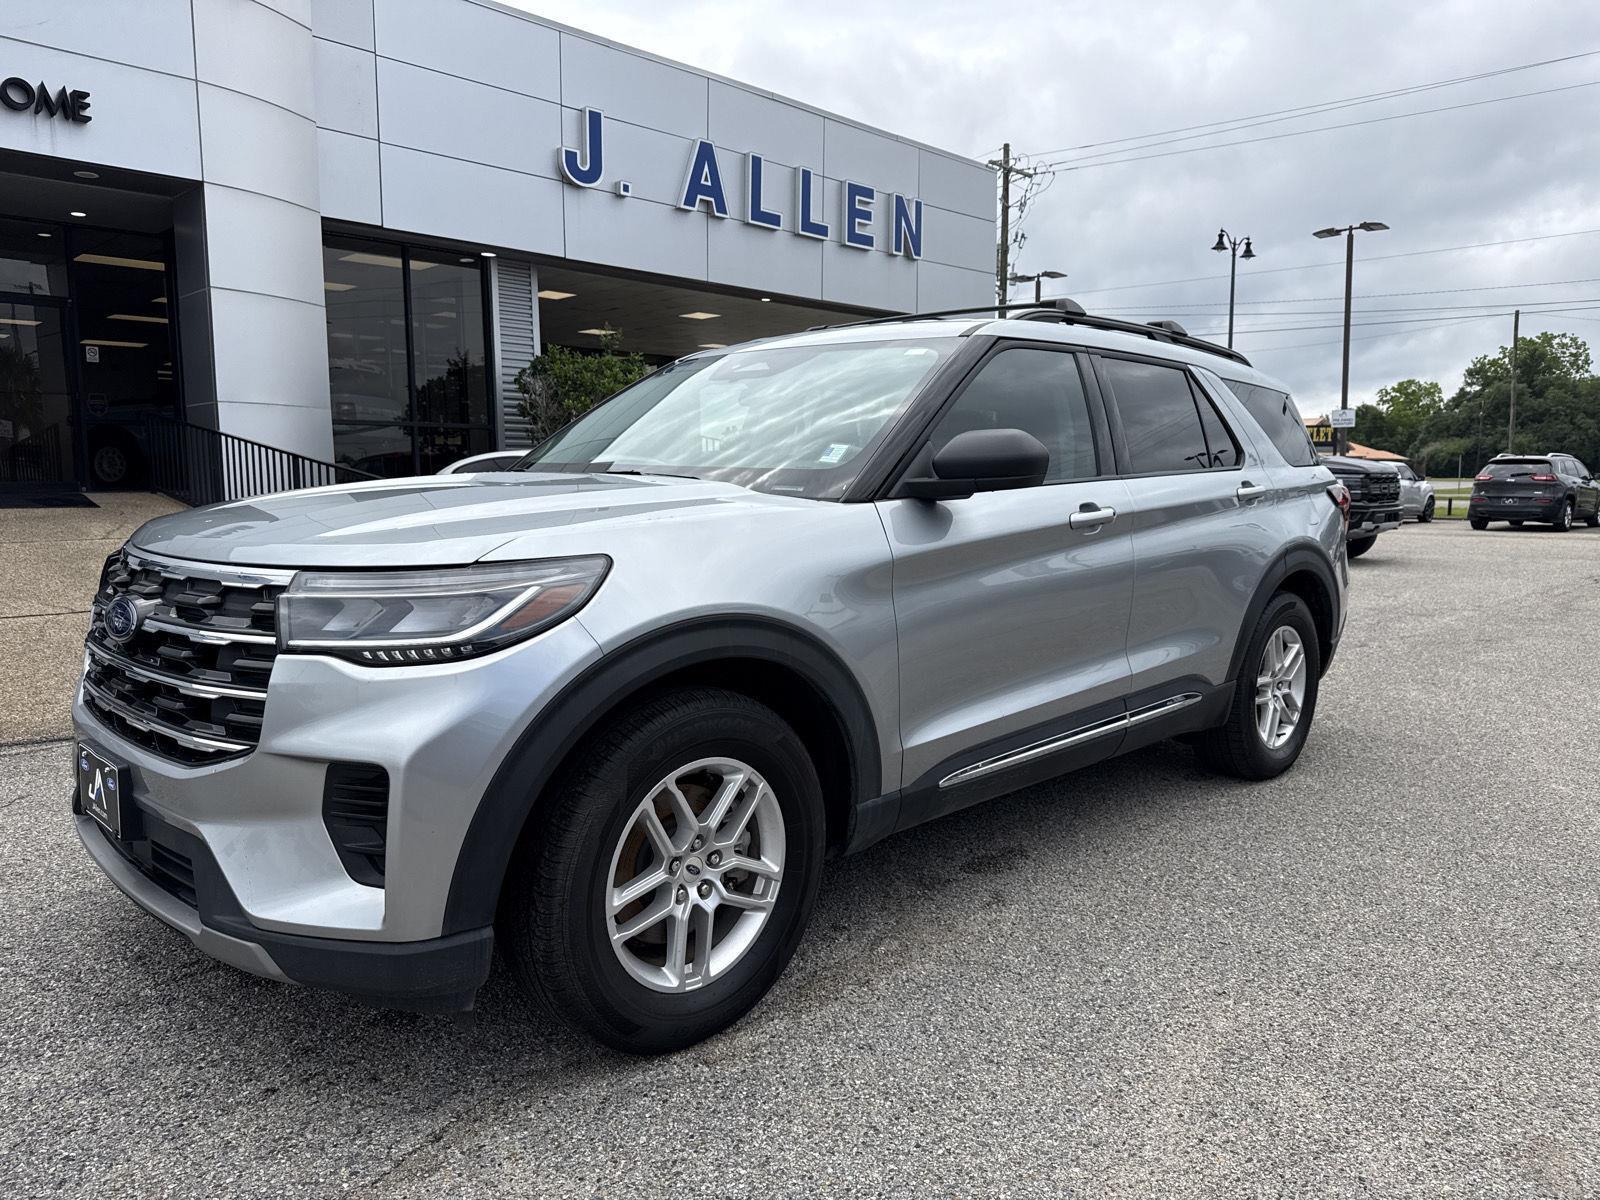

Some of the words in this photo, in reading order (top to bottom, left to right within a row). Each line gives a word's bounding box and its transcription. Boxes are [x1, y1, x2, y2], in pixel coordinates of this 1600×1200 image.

[0, 76, 93, 124] OME
[558, 106, 632, 197] J.
[675, 137, 924, 260] ALLEN
